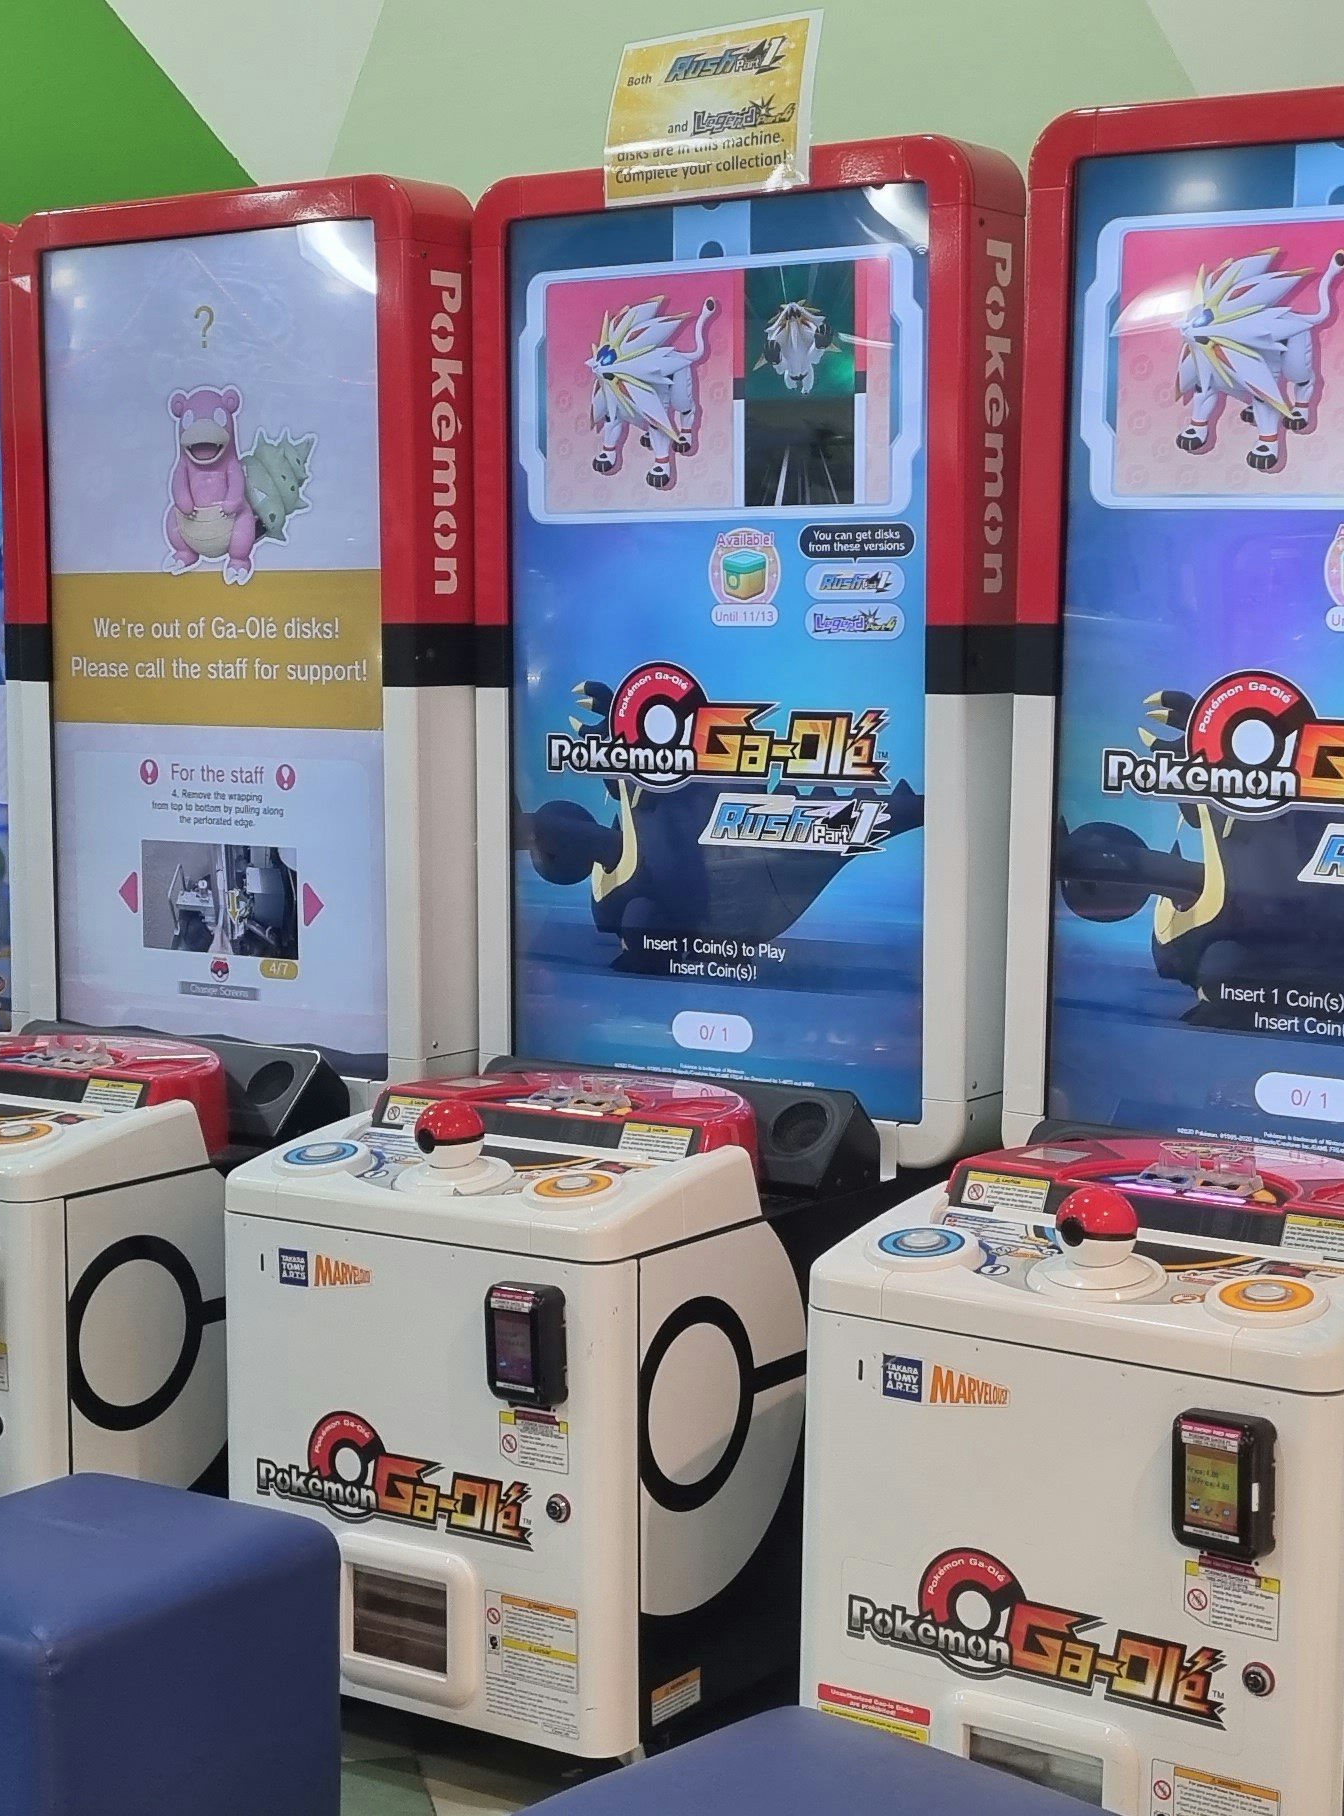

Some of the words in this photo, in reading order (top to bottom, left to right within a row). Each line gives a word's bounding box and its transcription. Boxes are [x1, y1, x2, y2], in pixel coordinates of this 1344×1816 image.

[627, 74, 652, 86] Both
[664, 50, 737, 83] Rush
[735, 59, 760, 72] Part
[668, 120, 688, 134] and
[693, 105, 756, 135] Legend
[653, 144, 673, 158] are
[722, 131, 784, 150] machine.
[616, 166, 677, 184] Complete
[682, 163, 711, 179] your
[716, 150, 788, 172] collection!
[193, 305, 214, 349] ?
[983, 237, 1013, 594] Pokémon
[430, 269, 463, 596] Pokémon
[717, 532, 774, 547] Available!
[809, 542, 830, 552] from
[834, 542, 861, 552] these
[863, 540, 905, 552] versions
[813, 530, 832, 541] You
[834, 532, 852, 540] can
[855, 531, 872, 542] get
[874, 529, 900, 540] disks
[819, 573, 864, 590] Rush
[93, 617, 145, 640] We're
[152, 619, 181, 640] out
[187, 617, 206, 639] of
[211, 616, 278, 640] Ga-Olé
[284, 617, 340, 640] disks!
[715, 611, 739, 622] Until
[743, 611, 774, 622] 11/13
[813, 613, 865, 633] Legend
[71, 656, 129, 678] Please
[135, 657, 166, 680] call
[172, 657, 201, 679] the
[207, 658, 248, 680] staff
[255, 659, 280, 680] for
[286, 660, 367, 685] support!
[618, 675, 651, 718] Pokémon
[655, 672, 689, 691] Ga-Olé
[1199, 685, 1243, 733] Pokémon
[1248, 682, 1292, 704] Ga-Olé
[550, 737, 696, 772] Pokémon
[695, 707, 887, 775] Ga-Olé
[171, 763, 195, 782] For
[200, 764, 225, 782] the
[230, 766, 264, 784] staff
[1106, 754, 1296, 797] Pokémon
[171, 789, 179, 799] 4.
[181, 789, 211, 800] Remove
[214, 791, 226, 801] the
[228, 793, 263, 803] wrapping
[152, 801, 169, 810] from
[171, 803, 183, 813] top
[185, 803, 193, 811] to
[195, 803, 221, 813] bottom
[223, 805, 232, 815] by
[235, 805, 260, 816] pulling
[262, 806, 284, 818] along
[179, 815, 191, 824] the
[193, 816, 232, 827] perforated
[234, 818, 255, 828] edge.
[710, 801, 814, 841] Rush
[812, 824, 850, 845] Part
[848, 801, 880, 845] 1
[643, 934, 679, 952] Insert
[682, 938, 688, 952] 1
[693, 938, 738, 958] Coin(s)
[742, 942, 755, 957] to
[758, 943, 786, 962] Play
[269, 960, 288, 975] 4/7
[669, 959, 704, 977] Insert
[707, 962, 758, 981] Coin(s)!
[1220, 983, 1265, 1004] Insert
[1271, 989, 1279, 1005] 1
[1286, 991, 1344, 1014] Coin(s)
[698, 1024, 715, 1041] 0/
[721, 1027, 729, 1042] 1
[1254, 1012, 1300, 1033] Insert
[1290, 1088, 1311, 1108] 0/
[1320, 1093, 1328, 1109] 1
[282, 1262, 305, 1271] TOMY
[886, 1371, 918, 1383] TOMY
[887, 1363, 918, 1375] TAKARA
[259, 1461, 377, 1510] Pokémon
[375, 1454, 529, 1538] Ga-Olé
[928, 1559, 964, 1595] Pokémon
[969, 1558, 1006, 1582] Ga-Olé
[850, 1598, 1010, 1666] Pokémon
[1009, 1603, 1223, 1712] Ga-Olé
